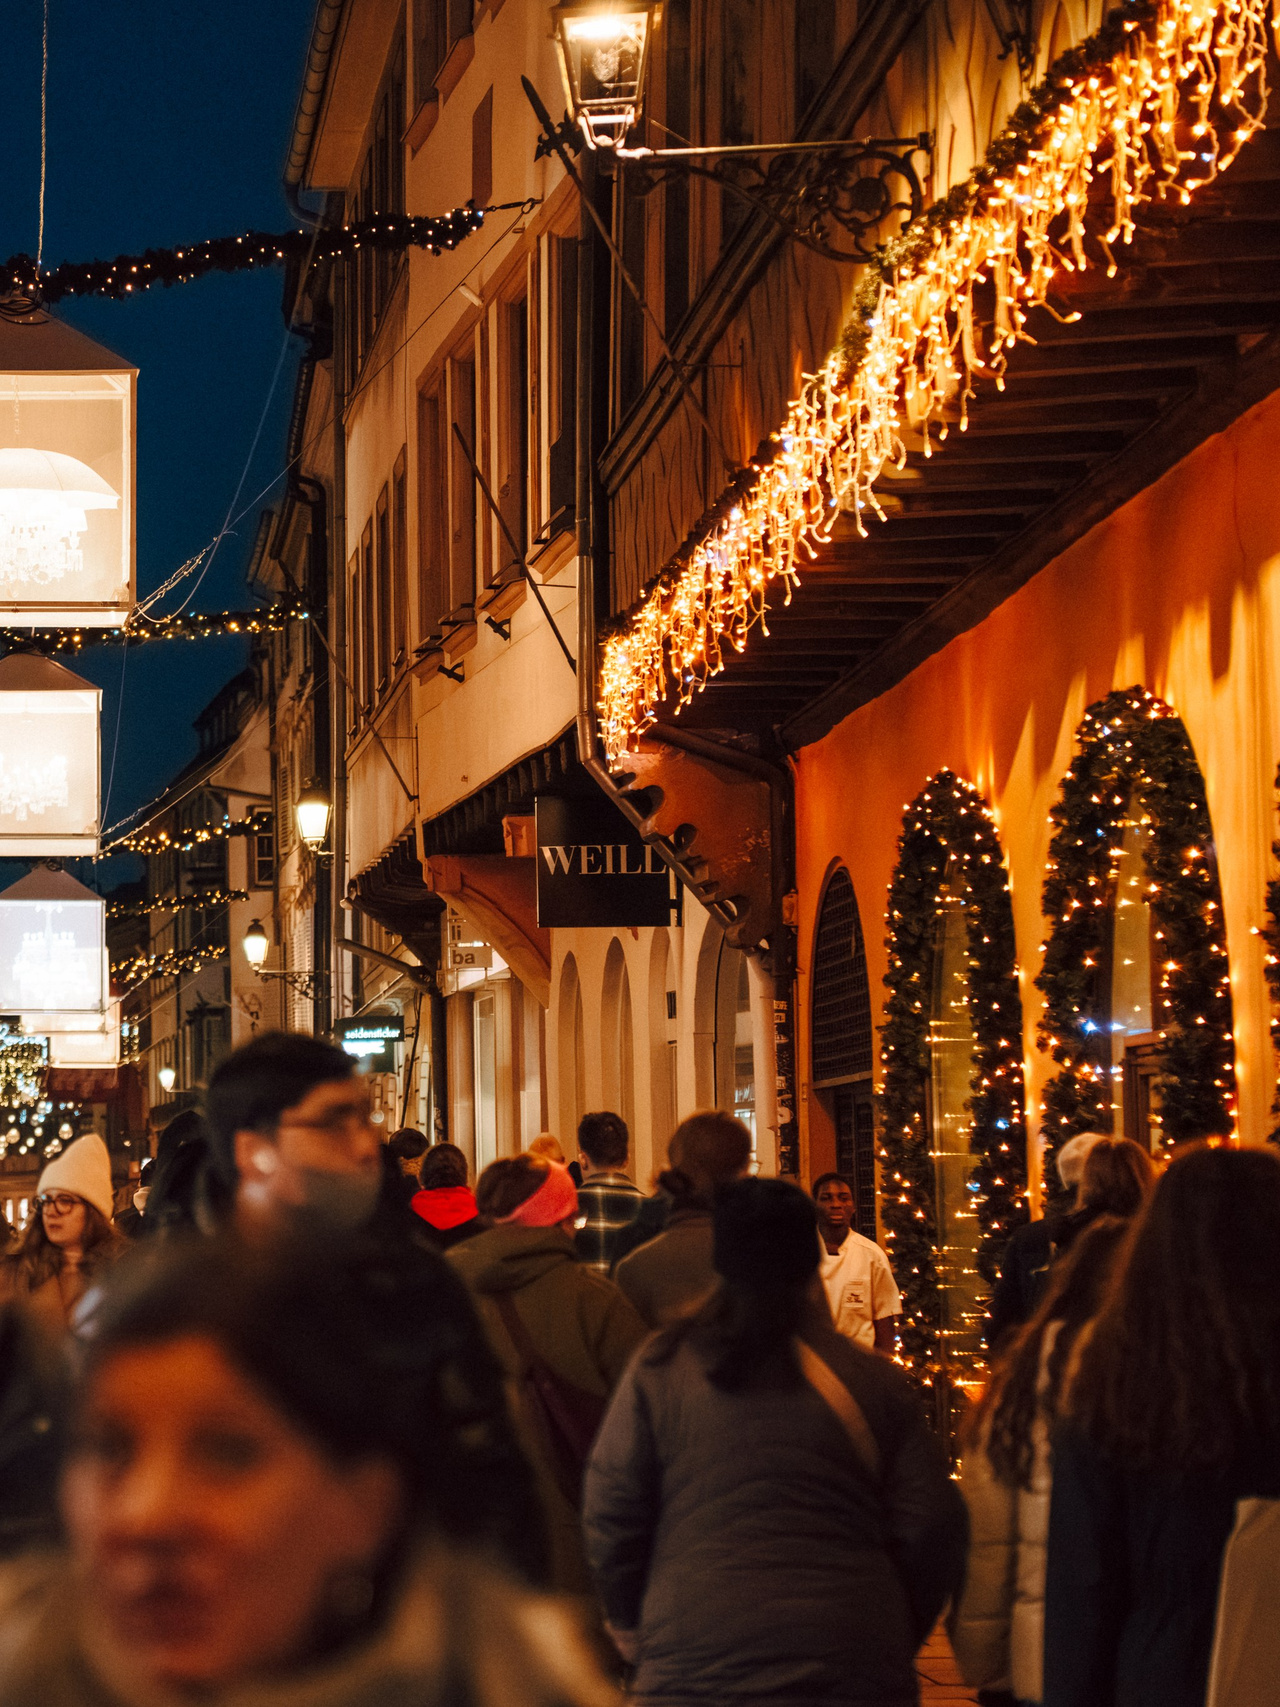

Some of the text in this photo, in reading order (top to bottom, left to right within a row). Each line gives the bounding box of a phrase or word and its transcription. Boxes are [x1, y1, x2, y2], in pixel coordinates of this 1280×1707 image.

[539, 844, 667, 875] WEILL
[452, 950, 475, 964] ba
[345, 1026, 400, 1039] seidensticker
